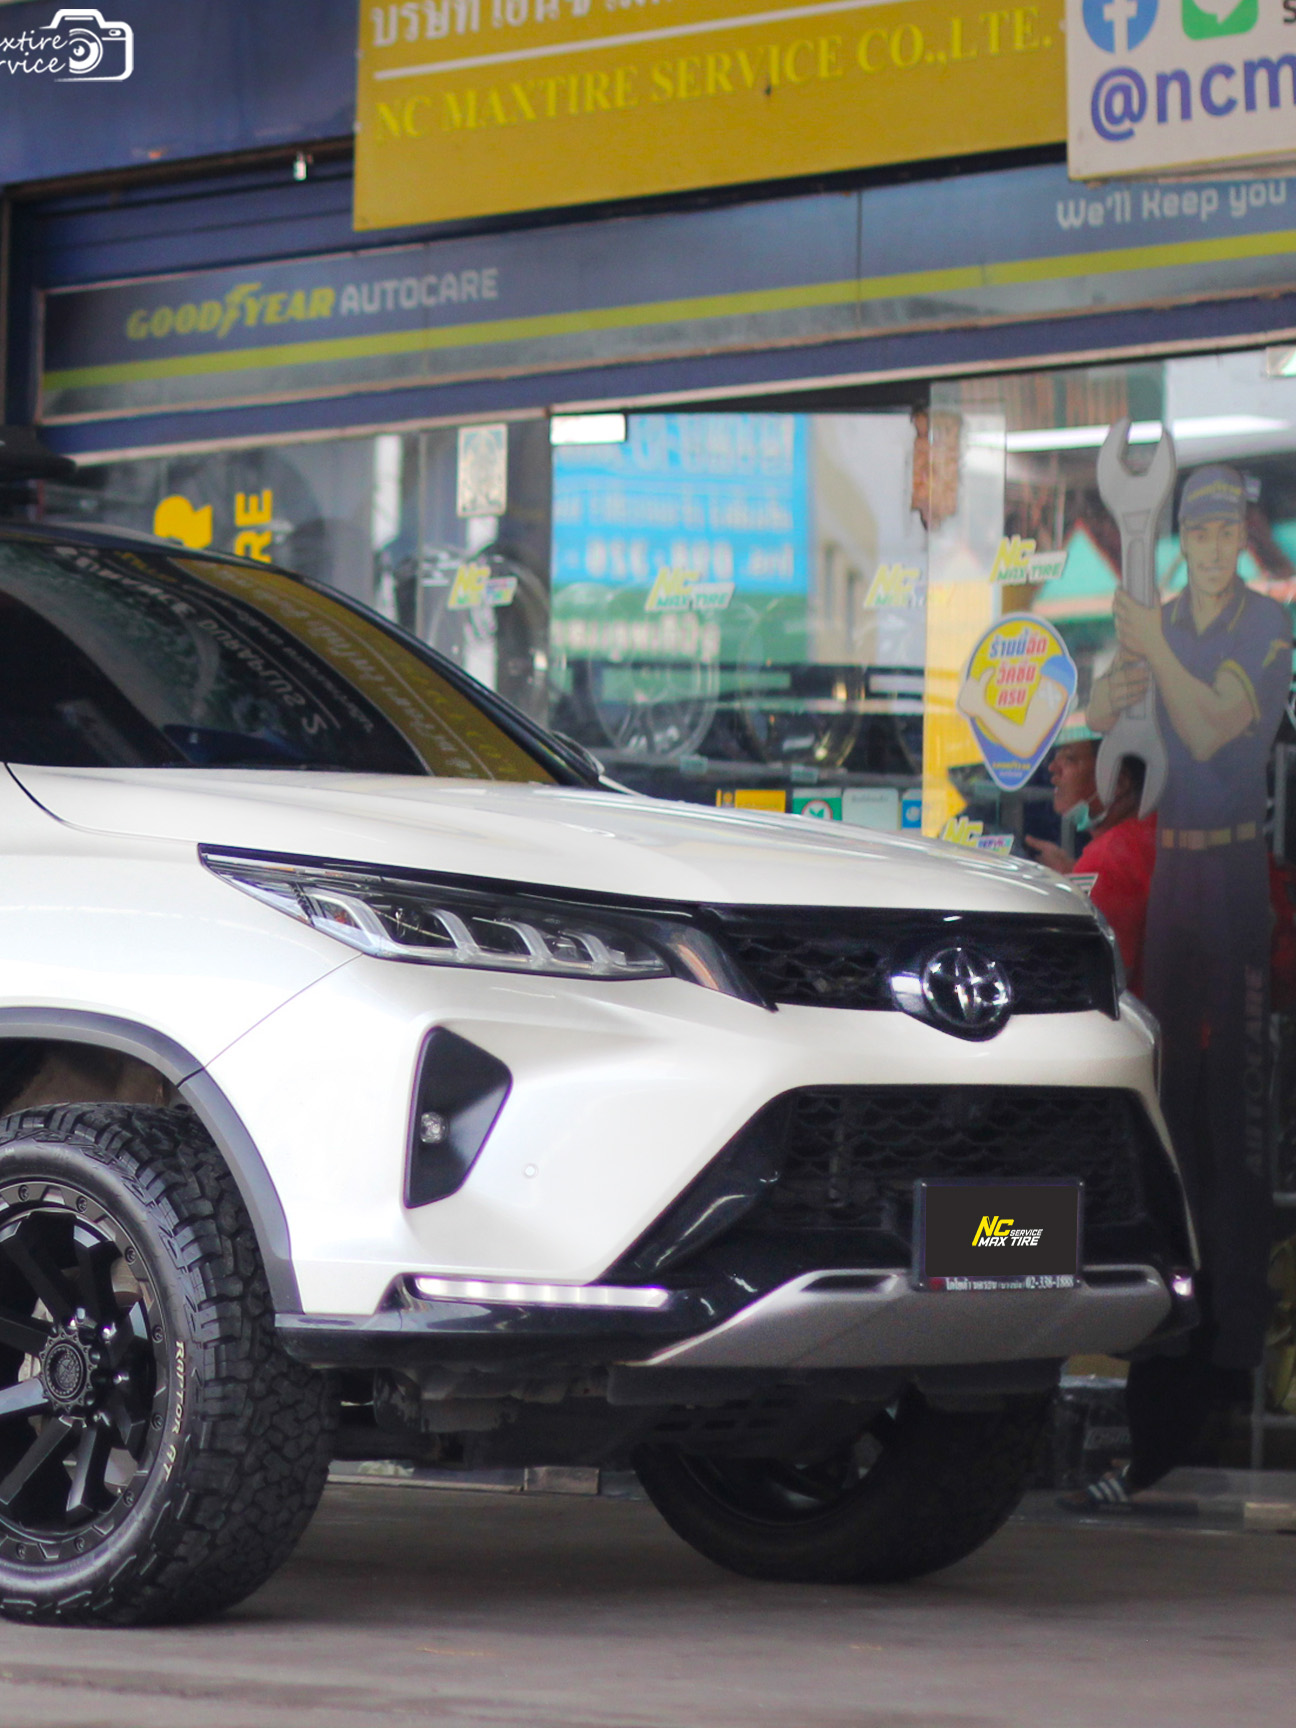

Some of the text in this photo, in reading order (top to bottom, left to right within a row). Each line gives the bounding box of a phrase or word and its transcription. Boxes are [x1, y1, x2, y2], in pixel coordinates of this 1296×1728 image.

[375, 96, 431, 144] NC
[442, 66, 639, 132] MAXTIRE
[652, 36, 844, 104] SERVICE
[1057, 190, 1131, 230] We'll
[1229, 180, 1286, 218] you
[126, 268, 499, 340] GOODYEAR AUTOCARE
[172, 1341, 186, 1434] RAPTOR
